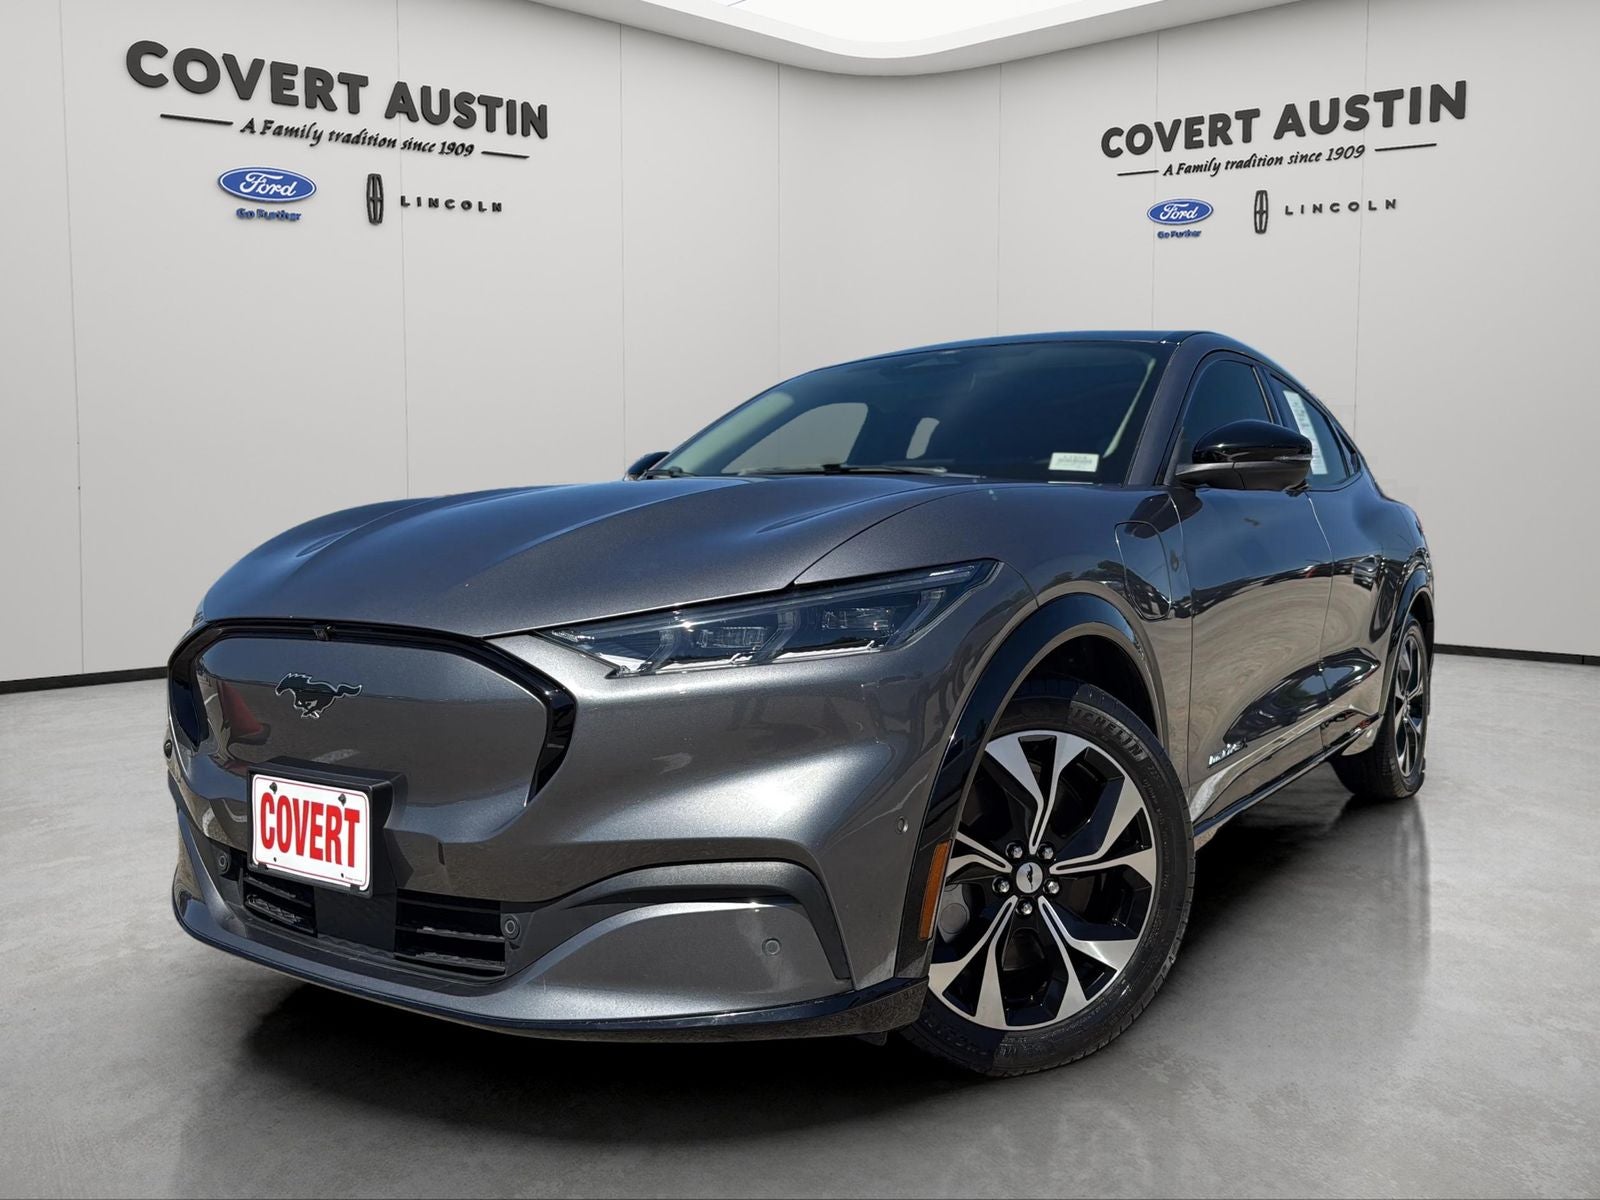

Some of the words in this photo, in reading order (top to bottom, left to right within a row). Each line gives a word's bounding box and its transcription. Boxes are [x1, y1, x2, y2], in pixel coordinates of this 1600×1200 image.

[126, 40, 369, 114] COVERT
[384, 81, 549, 139] AUSTIN
[1100, 108, 1261, 158] COVERT
[1273, 80, 1467, 140] AUSTIN
[239, 117, 257, 135] A
[259, 119, 324, 147] Family
[328, 128, 397, 149] tradition
[400, 137, 436, 153] since
[438, 141, 475, 157] 1909
[1163, 164, 1174, 176] A
[1176, 157, 1221, 177] Family
[1224, 153, 1284, 171] tradition
[1287, 151, 1323, 165] since
[1325, 145, 1366, 161] 1909
[239, 172, 298, 197] Ford
[236, 208, 256, 220] Go
[400, 195, 503, 213] LINCOLN
[1159, 203, 1199, 220] Ford
[1284, 199, 1397, 216] LINCOLN
[1157, 231, 1170, 239] Go
[1170, 229, 1202, 239] Further
[1068, 706, 1145, 760] ICHELIN
[260, 792, 360, 868] COVERT
